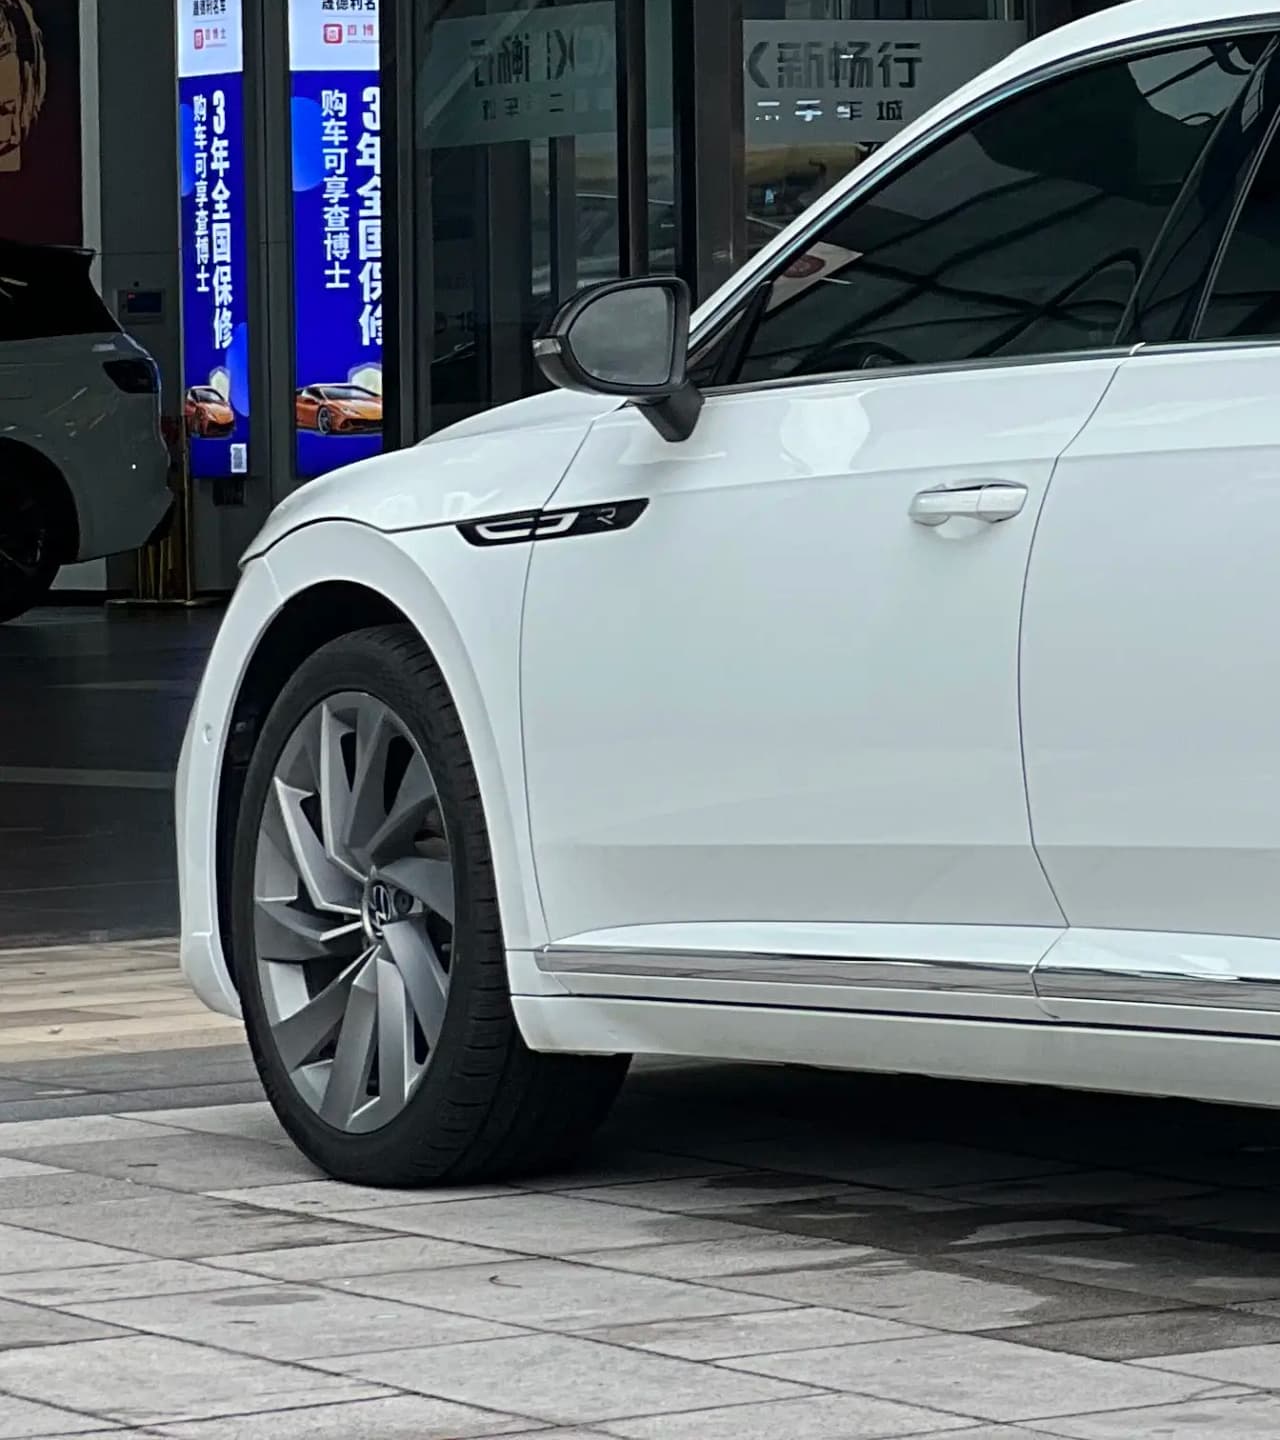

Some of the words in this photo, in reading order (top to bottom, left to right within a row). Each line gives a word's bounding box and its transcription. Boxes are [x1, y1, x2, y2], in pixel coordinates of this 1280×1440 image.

[192, 94, 210, 293] 购车可享查博士
[210, 89, 234, 350] 3年全国保修
[321, 89, 350, 290] 购车可享查博士
